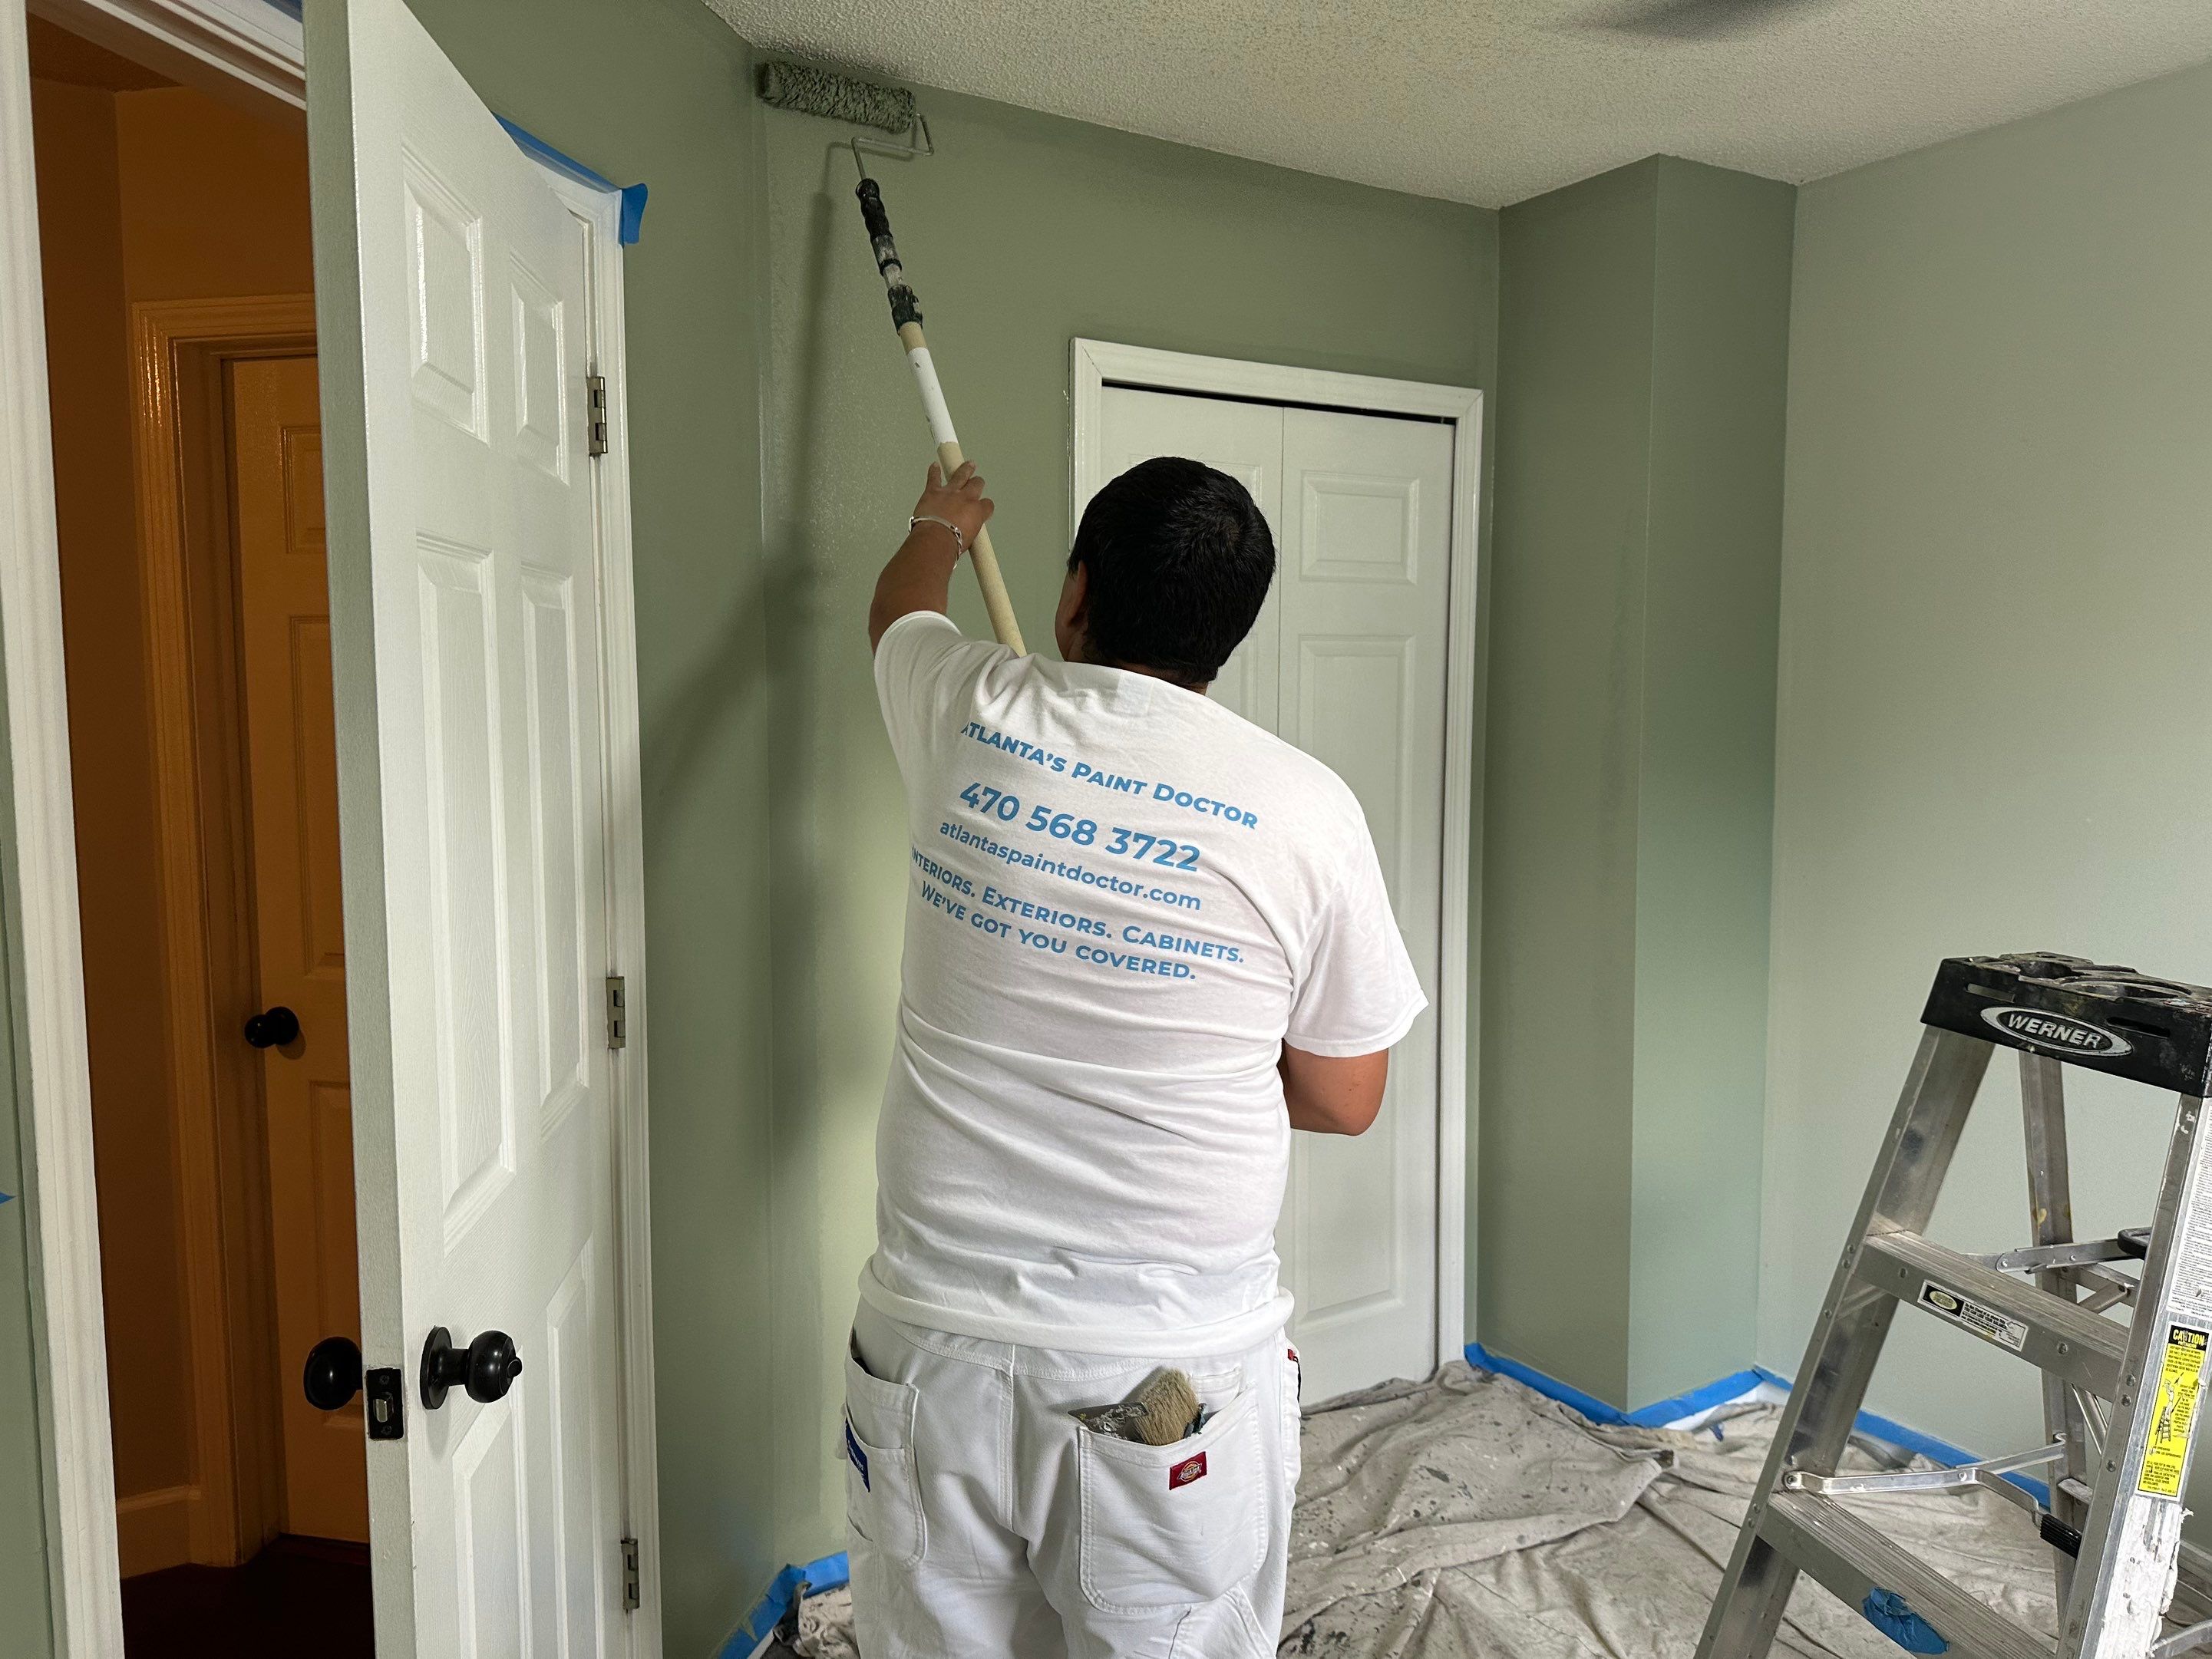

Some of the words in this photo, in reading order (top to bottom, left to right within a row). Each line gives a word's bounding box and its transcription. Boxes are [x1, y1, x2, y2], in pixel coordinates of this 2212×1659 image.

[960, 783, 1020, 821] 470
[1025, 806, 1098, 846] 568
[1106, 828, 1200, 872] 3722
[1071, 762, 1147, 795] PAINT
[1153, 783, 1258, 829] DOCTOR
[940, 821, 1201, 910] atlantaspaintdoctor.com
[922, 881, 966, 920] WE'VE
[971, 913, 1012, 938] GOT
[1019, 930, 1067, 955] YOU
[1075, 946, 1195, 979] COVERED.
[982, 887, 1111, 938] EXTERIORS.
[1122, 925, 1243, 962] CABINETS.
[2008, 1013, 2101, 1049] WERNER
